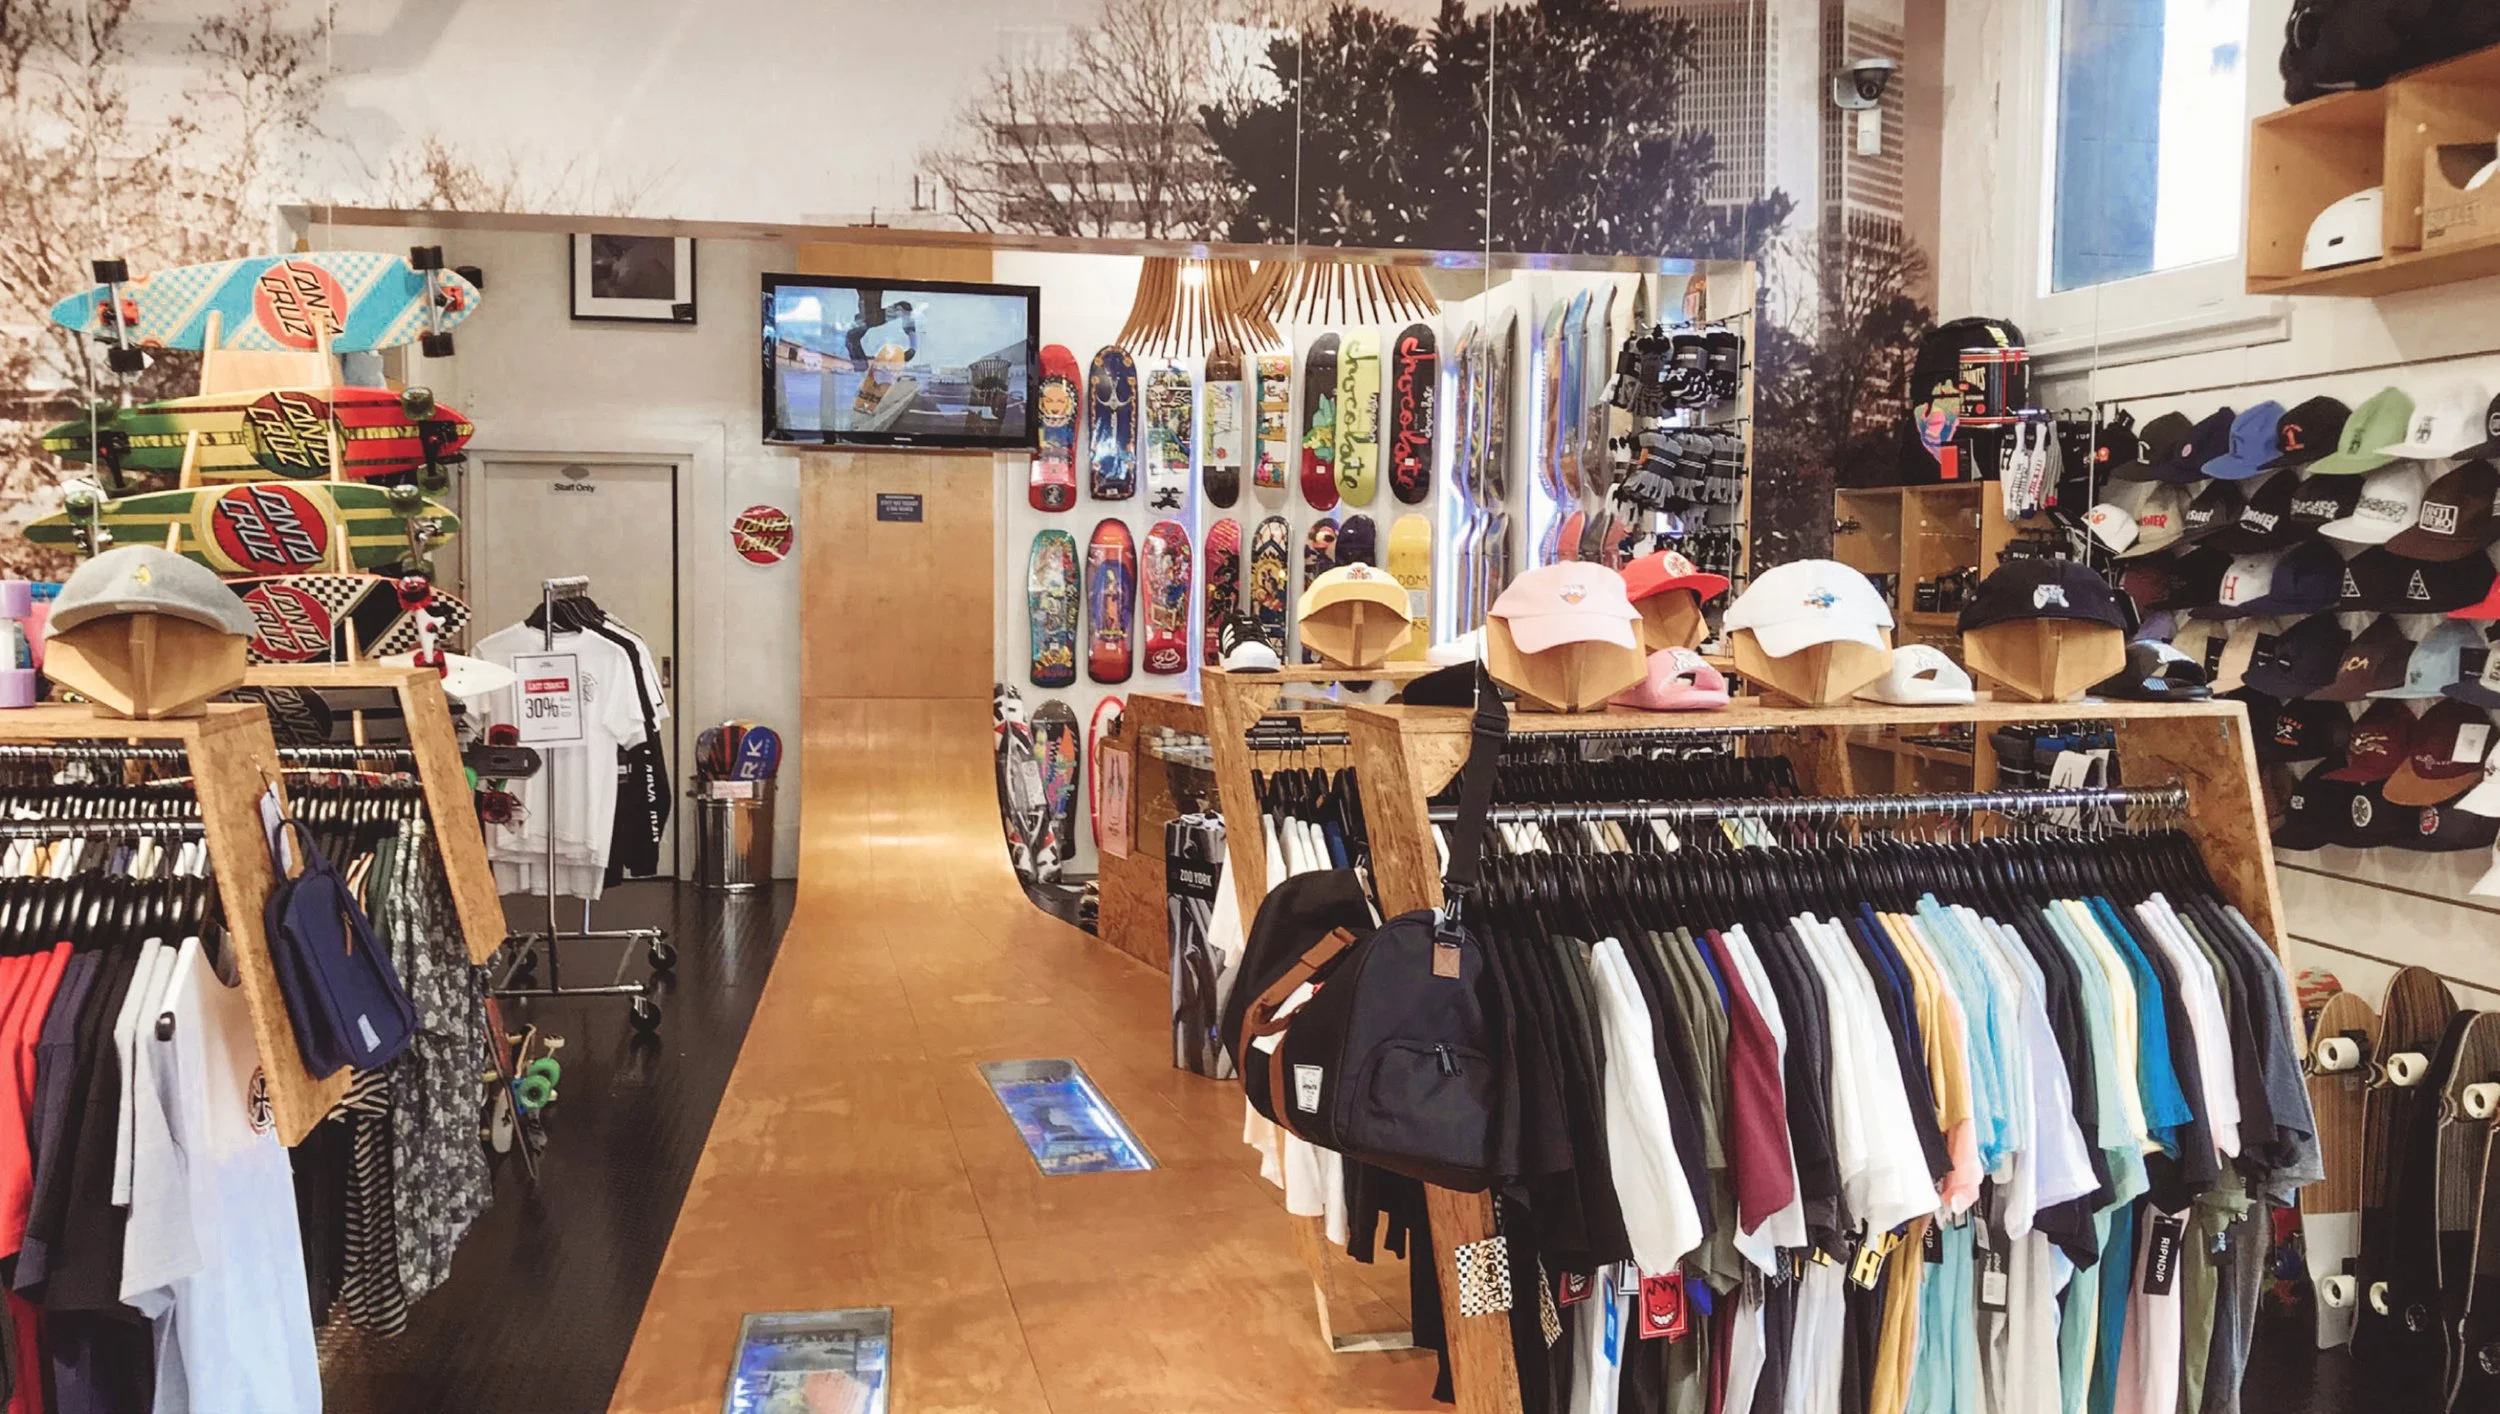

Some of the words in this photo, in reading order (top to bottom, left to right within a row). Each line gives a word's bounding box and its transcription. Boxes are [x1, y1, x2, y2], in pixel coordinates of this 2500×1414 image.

[260, 276, 313, 337] CRUZ
[246, 406, 313, 468] CRUZ
[1340, 340, 1378, 489] chocolate
[1394, 337, 1436, 489] chocolate
[576, 483, 596, 494] Only
[217, 497, 287, 564] CRUZ
[248, 485, 325, 563] SANTA
[259, 582, 331, 653] SANTA
[2222, 574, 2239, 600] H
[525, 697, 560, 719] 30%
[1180, 868, 1194, 883] ZOO
[1194, 871, 1213, 888] YORK
[2155, 1236, 2171, 1283] RIPNDIP
